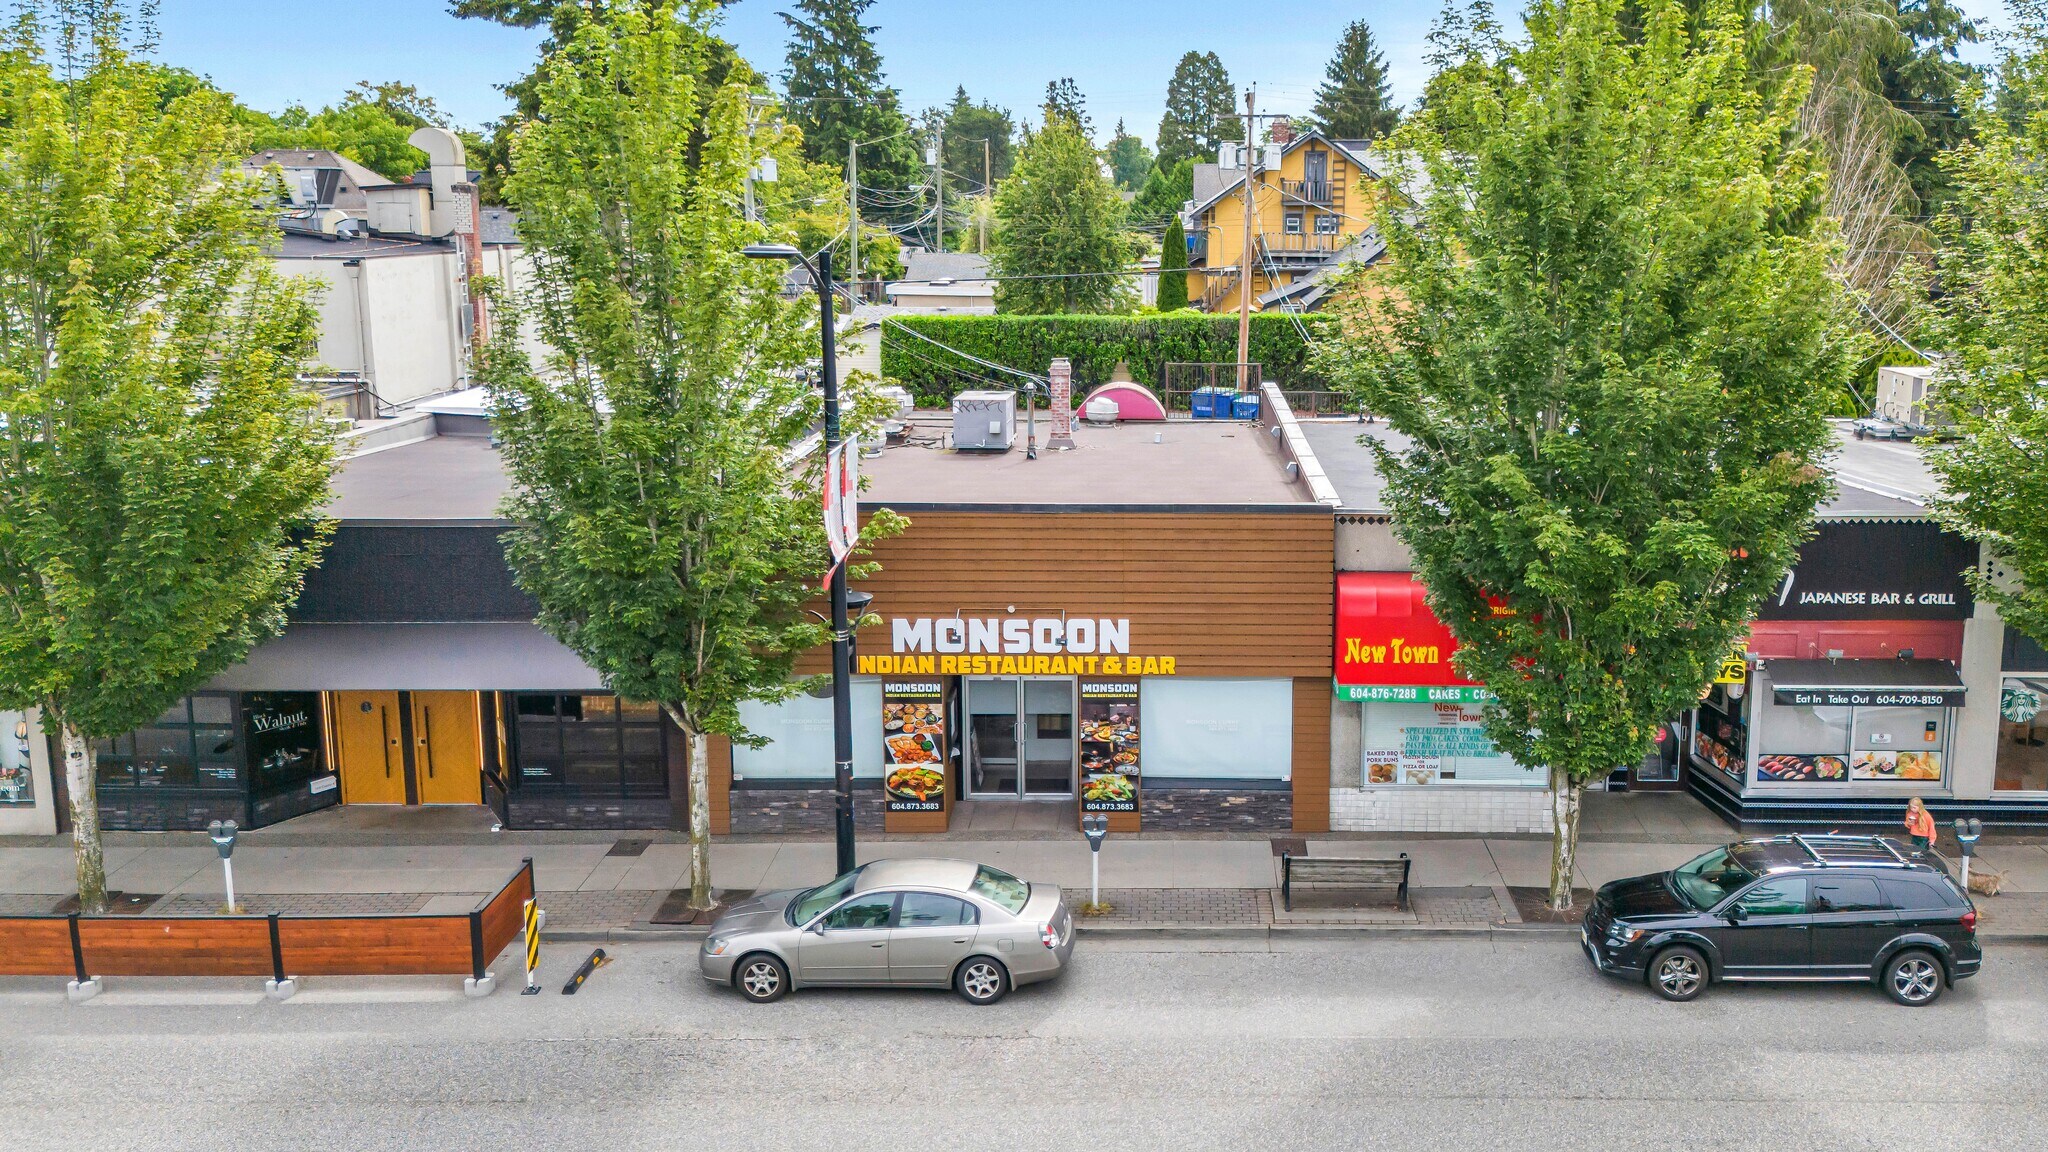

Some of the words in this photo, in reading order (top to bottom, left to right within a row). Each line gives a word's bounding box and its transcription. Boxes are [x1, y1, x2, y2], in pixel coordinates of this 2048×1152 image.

[1800, 592, 1866, 605] JAPANESE
[1871, 592, 1900, 605] BAR
[1904, 593, 1915, 605] &
[1919, 593, 1956, 605] GRILL
[1490, 606, 1517, 615] RIGIN
[892, 618, 1130, 654] MONSOON
[1344, 637, 1387, 664] New
[1390, 638, 1439, 664] Town
[856, 655, 935, 674] NDIAN
[941, 655, 1099, 675] RESTAURANT
[1102, 656, 1123, 675] &
[1126, 656, 1176, 675] BAR
[885, 683, 941, 693] MONSOON
[1082, 683, 1138, 693] MONSOON
[1350, 688, 1416, 699] 604-876-7288
[1428, 689, 1461, 700] CAKES
[1795, 694, 1811, 704] Eat
[1813, 695, 1822, 704] In
[1828, 695, 1849, 704] Take
[1851, 695, 1870, 704] Out
[1876, 695, 1943, 705] 604-709-8150
[1434, 702, 1459, 713] New
[891, 802, 940, 810] 604.873.3683
[1086, 803, 1134, 811] 604.873.3683
